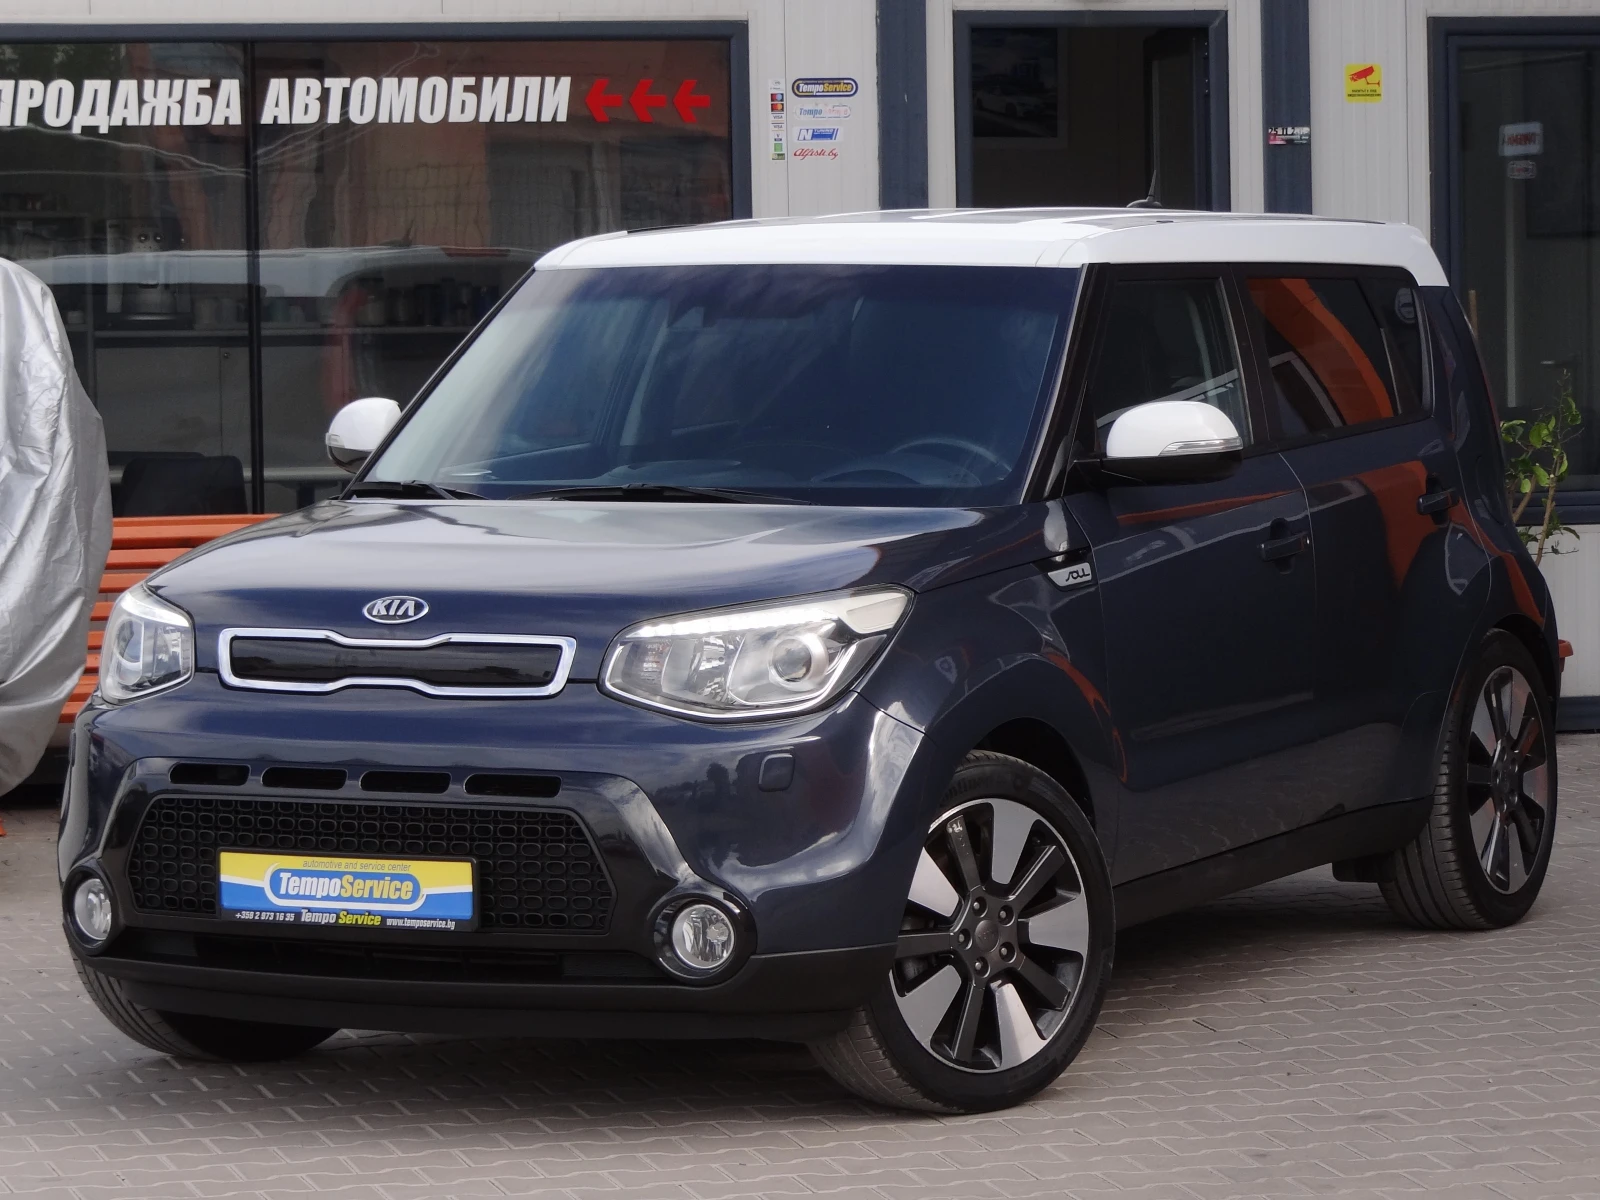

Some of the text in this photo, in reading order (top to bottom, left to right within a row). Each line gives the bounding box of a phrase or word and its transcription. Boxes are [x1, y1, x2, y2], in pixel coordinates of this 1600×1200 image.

[799, 83, 853, 95] TempoService
[260, 76, 571, 125] АВТОМОБИЛИ
[372, 599, 415, 616] KIA
[302, 859, 411, 872] automotive and service center
[279, 872, 414, 900] TempoService
[255, 911, 260, 919] 2
[261, 912, 274, 920] 973
[276, 912, 284, 921] 16
[285, 913, 295, 921] 35
[300, 909, 337, 924] Tempo
[338, 911, 382, 925] Service
[386, 918, 456, 930] www.temposervice.bg
